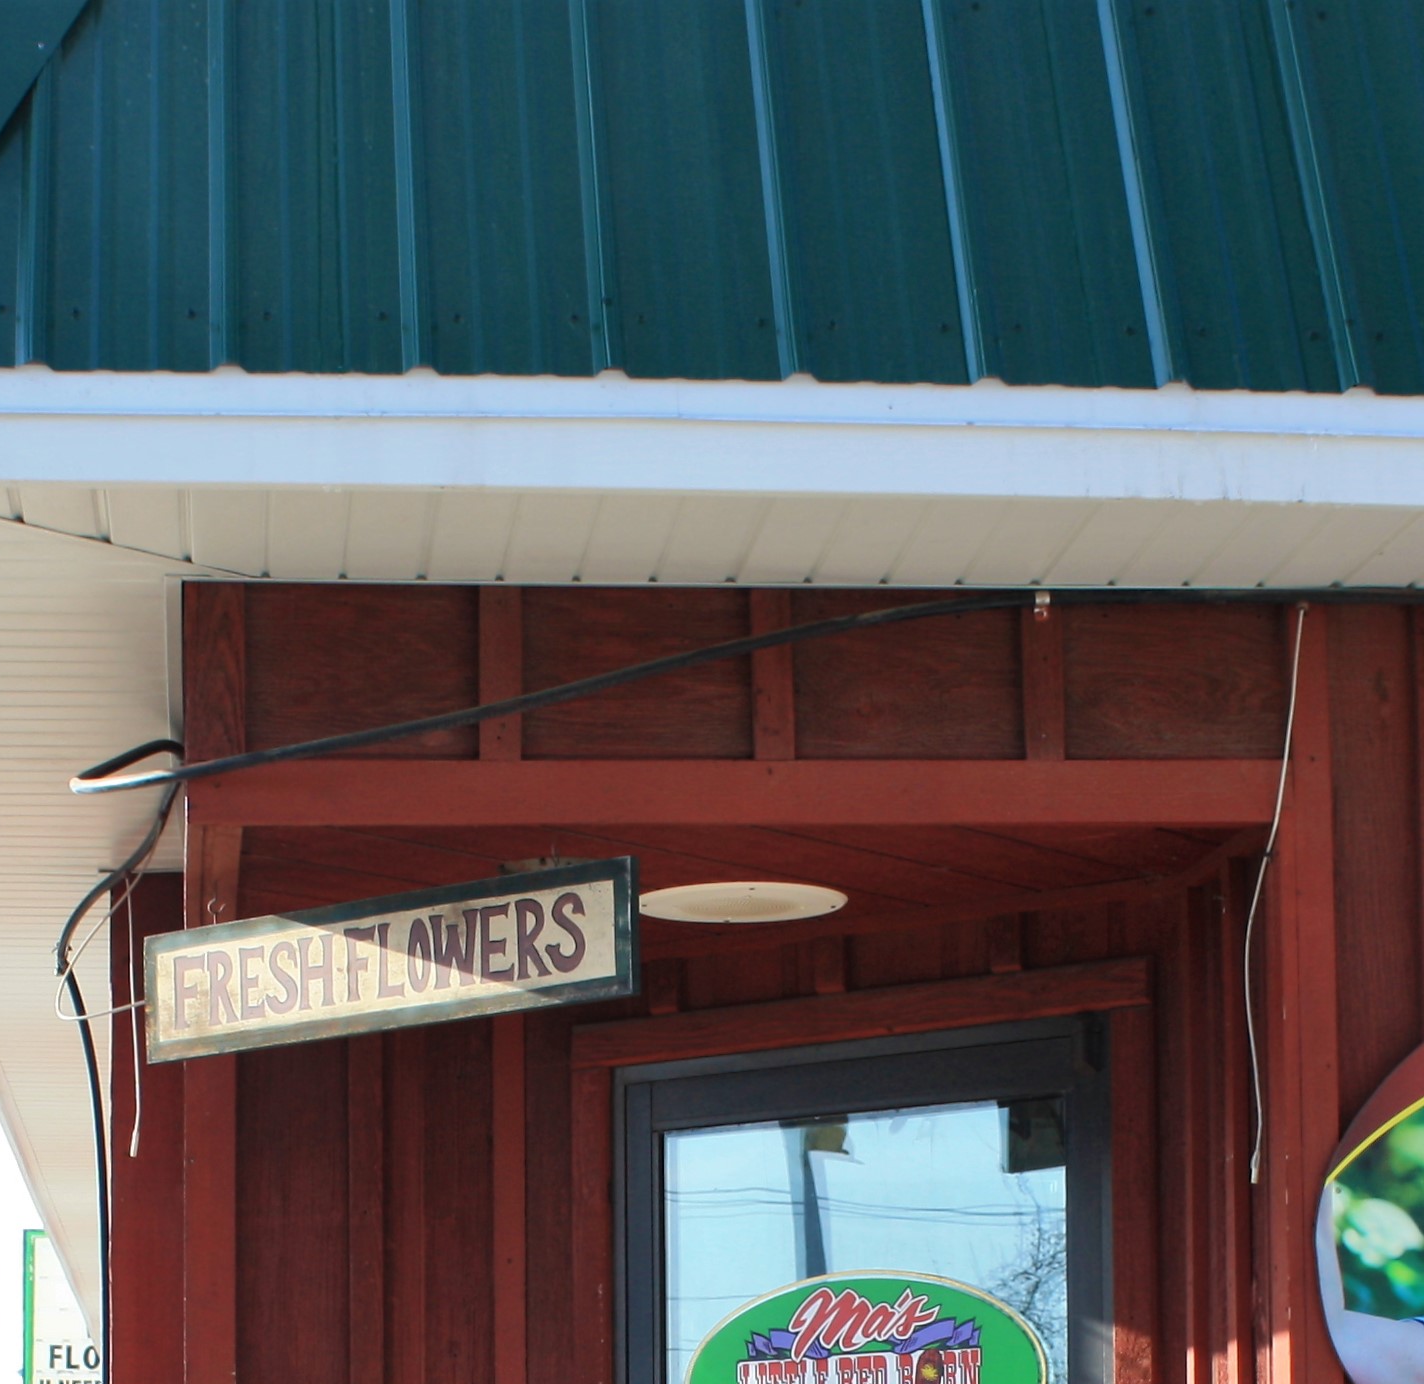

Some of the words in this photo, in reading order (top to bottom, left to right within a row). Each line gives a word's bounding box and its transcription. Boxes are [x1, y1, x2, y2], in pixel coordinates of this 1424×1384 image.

[172, 933, 338, 1030] FRESH
[343, 891, 587, 1003] FLOWERS
[789, 1286, 941, 1363] Ma's
